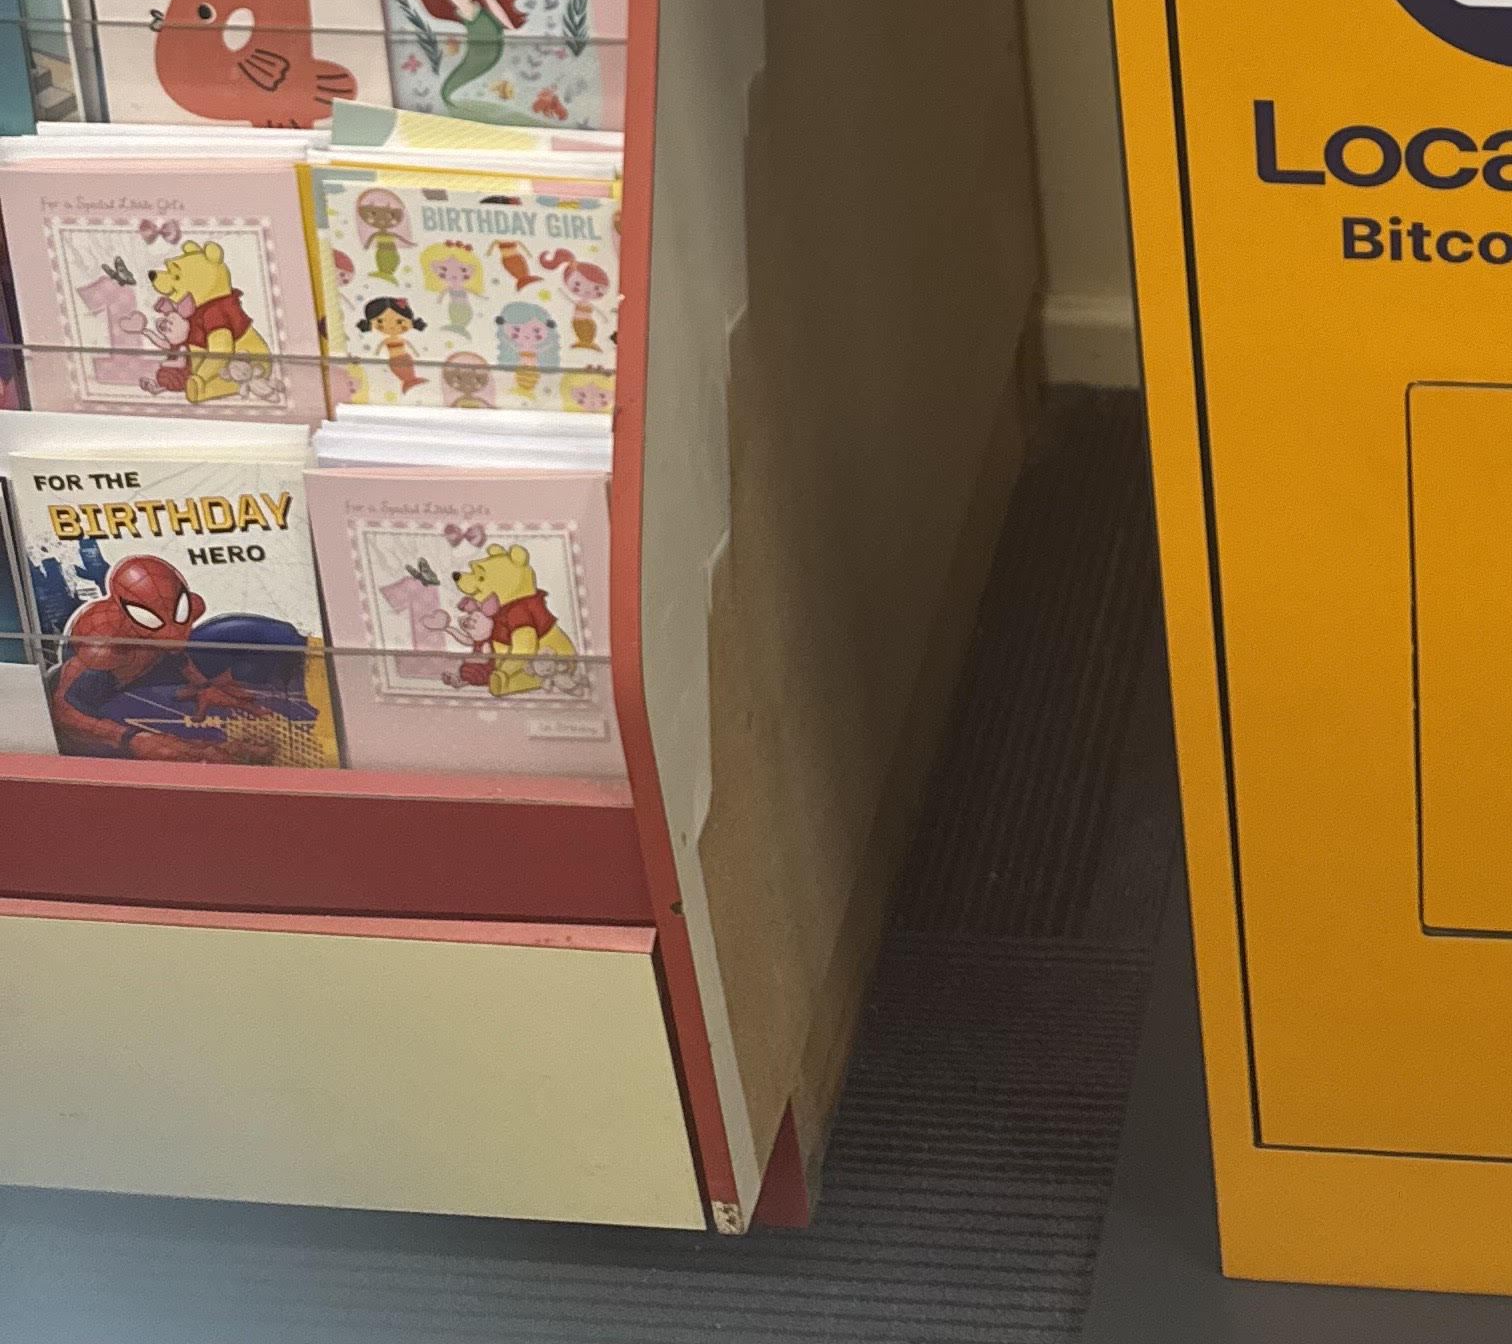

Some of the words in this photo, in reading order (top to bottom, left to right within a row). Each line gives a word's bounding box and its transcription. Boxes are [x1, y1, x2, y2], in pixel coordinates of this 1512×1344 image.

[422, 206, 537, 236] BIRTHDAY
[545, 213, 602, 240] GIRL
[33, 474, 83, 491] FOR
[88, 472, 141, 489] THE
[48, 492, 292, 540] BIRTHDAY
[188, 544, 266, 566] HERO
